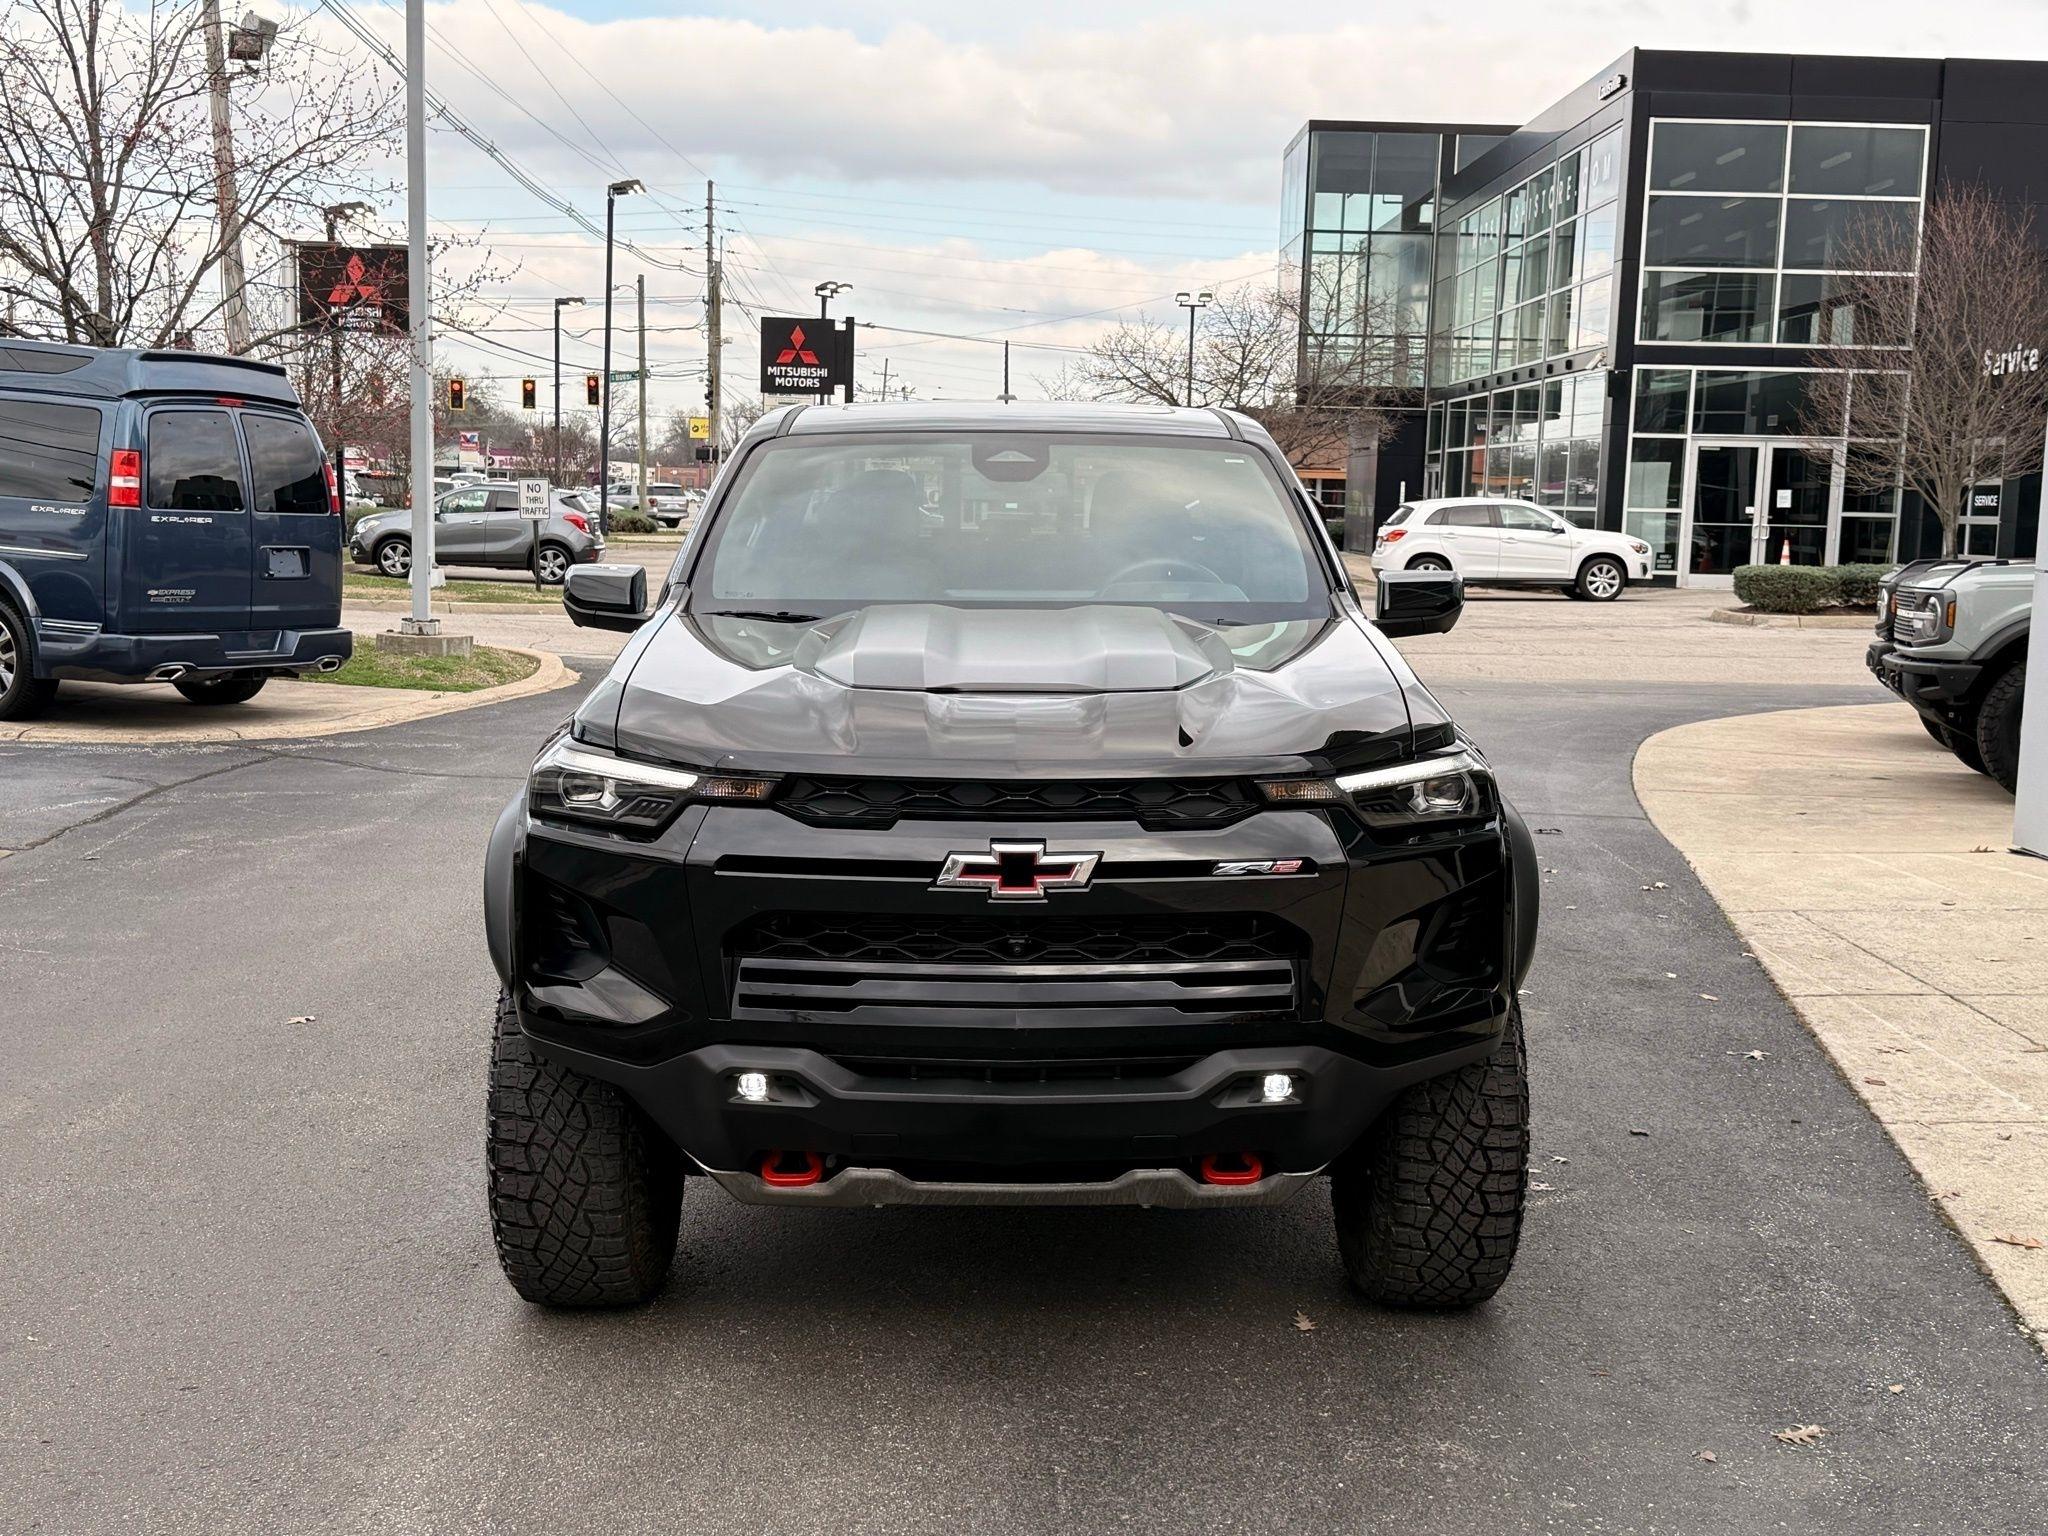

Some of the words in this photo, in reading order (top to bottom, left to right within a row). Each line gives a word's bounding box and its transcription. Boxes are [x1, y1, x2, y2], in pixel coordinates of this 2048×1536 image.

[1983, 343, 2039, 376] Service
[767, 366, 828, 378] MITSUBISHI
[775, 377, 820, 388] MOTORS
[526, 483, 542, 493] NO
[526, 496, 544, 505] THRU
[1974, 494, 1998, 507] SERVICE
[30, 505, 87, 515] EXPLORER
[521, 506, 549, 515] TRAFFIC
[151, 515, 213, 524] EXPLORER
[1211, 859, 1303, 876] ZR2
